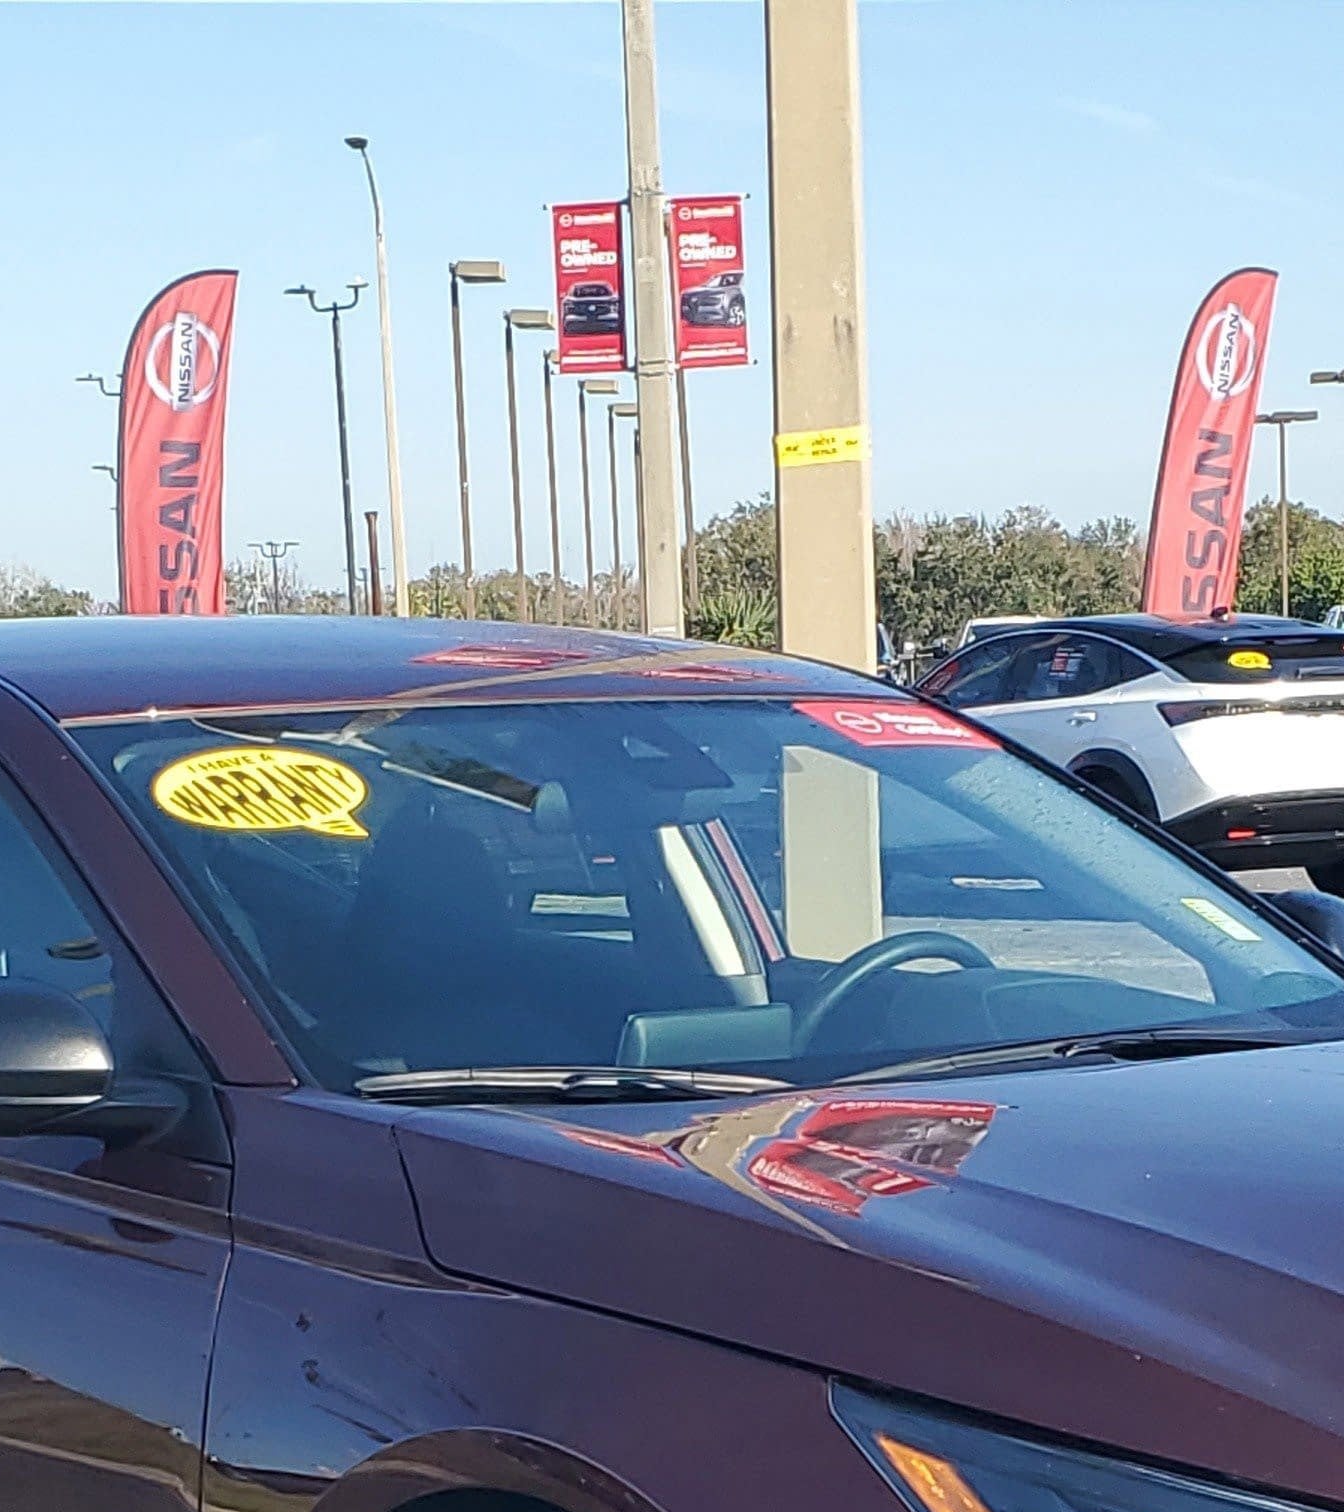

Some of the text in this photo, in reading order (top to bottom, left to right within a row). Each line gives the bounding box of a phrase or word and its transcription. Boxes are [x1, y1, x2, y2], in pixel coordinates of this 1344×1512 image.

[177, 321, 194, 403] NISSAN
[1217, 312, 1241, 399] NISSAN
[169, 764, 357, 824] WARRANTY
[200, 755, 256, 772] HAVE
